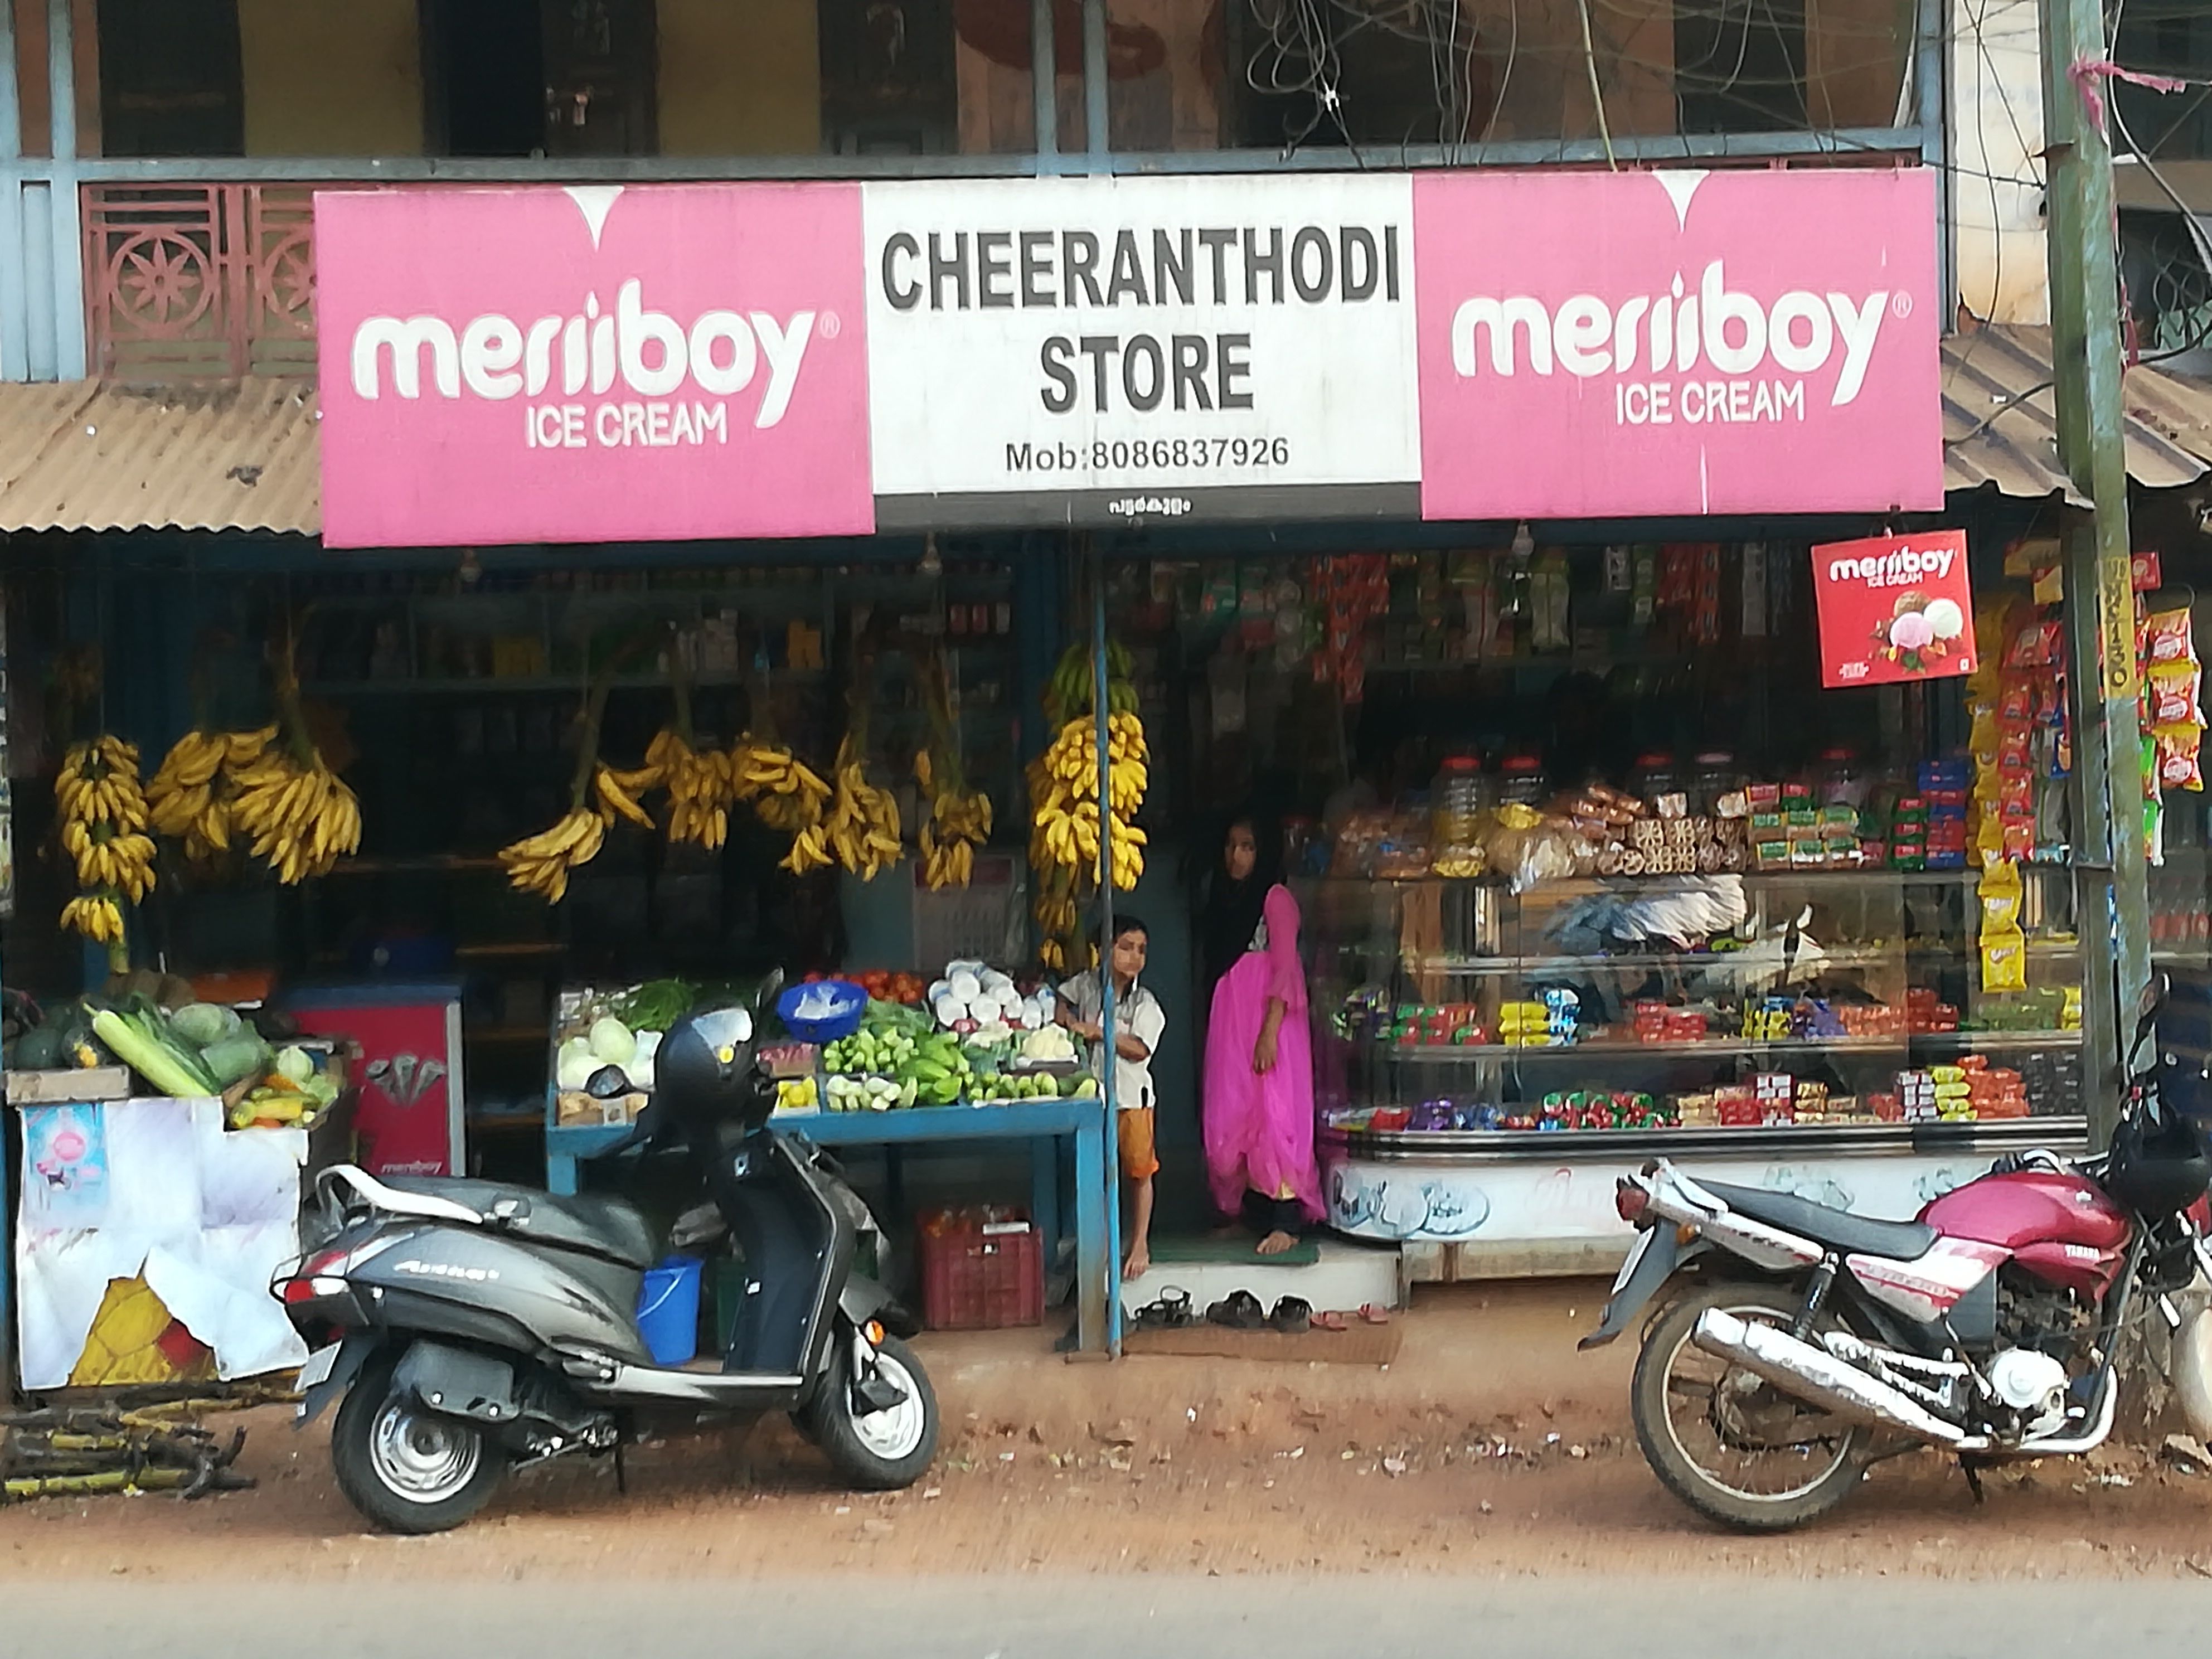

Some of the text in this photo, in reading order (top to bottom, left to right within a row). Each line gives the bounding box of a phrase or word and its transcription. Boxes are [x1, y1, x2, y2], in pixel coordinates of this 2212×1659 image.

[882, 225, 1399, 312] CHEERANTHODI
[1041, 333, 1254, 414] STORE
[527, 401, 727, 448] ICE CREAM
[1616, 380, 1804, 425] ICE CREAM
[1006, 437, 1289, 472] Mob:8086837926
